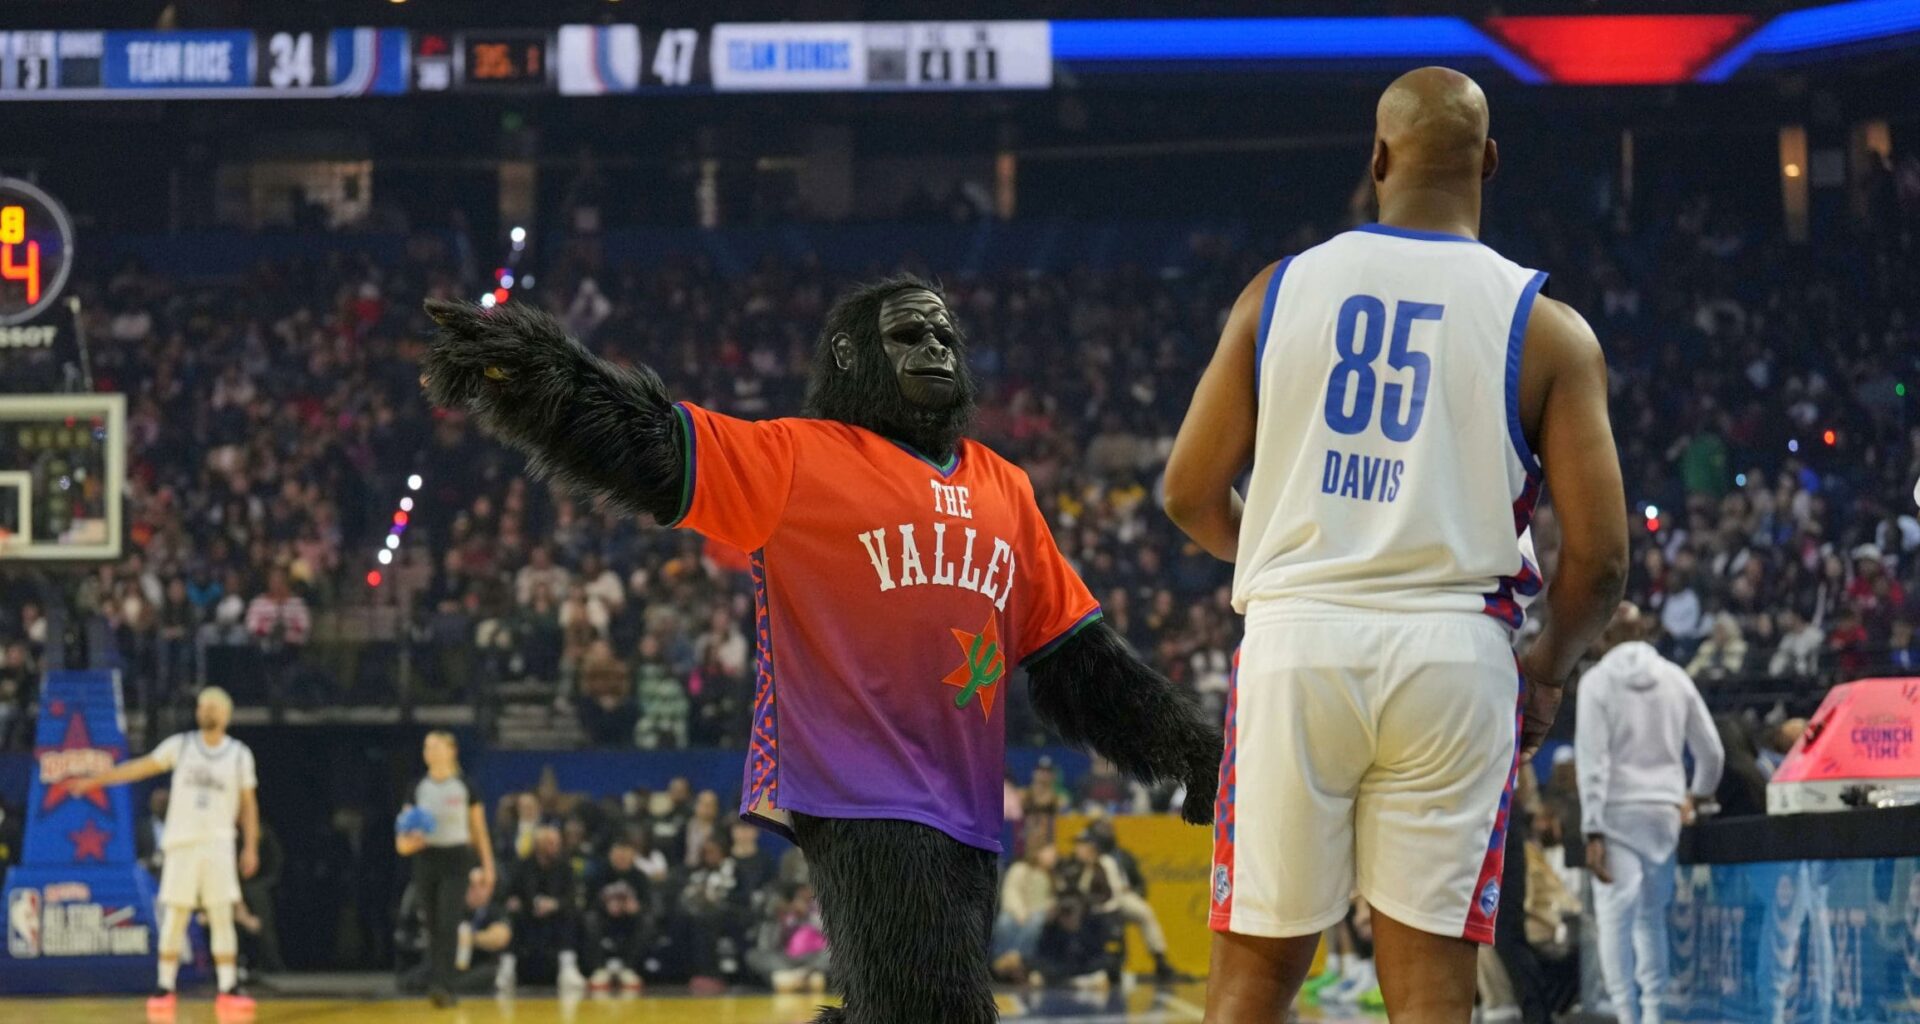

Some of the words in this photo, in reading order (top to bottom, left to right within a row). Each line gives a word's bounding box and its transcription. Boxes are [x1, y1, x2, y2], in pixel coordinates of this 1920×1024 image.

[127, 41, 181, 82] TEAM
[269, 31, 314, 89] 34
[651, 28, 698, 86] 47
[1324, 294, 1445, 443] 85
[930, 478, 973, 519] THE
[1321, 449, 1404, 503] DAVIS
[1851, 726, 1914, 745] CRUNCH
[1864, 743, 1901, 760] TIME
